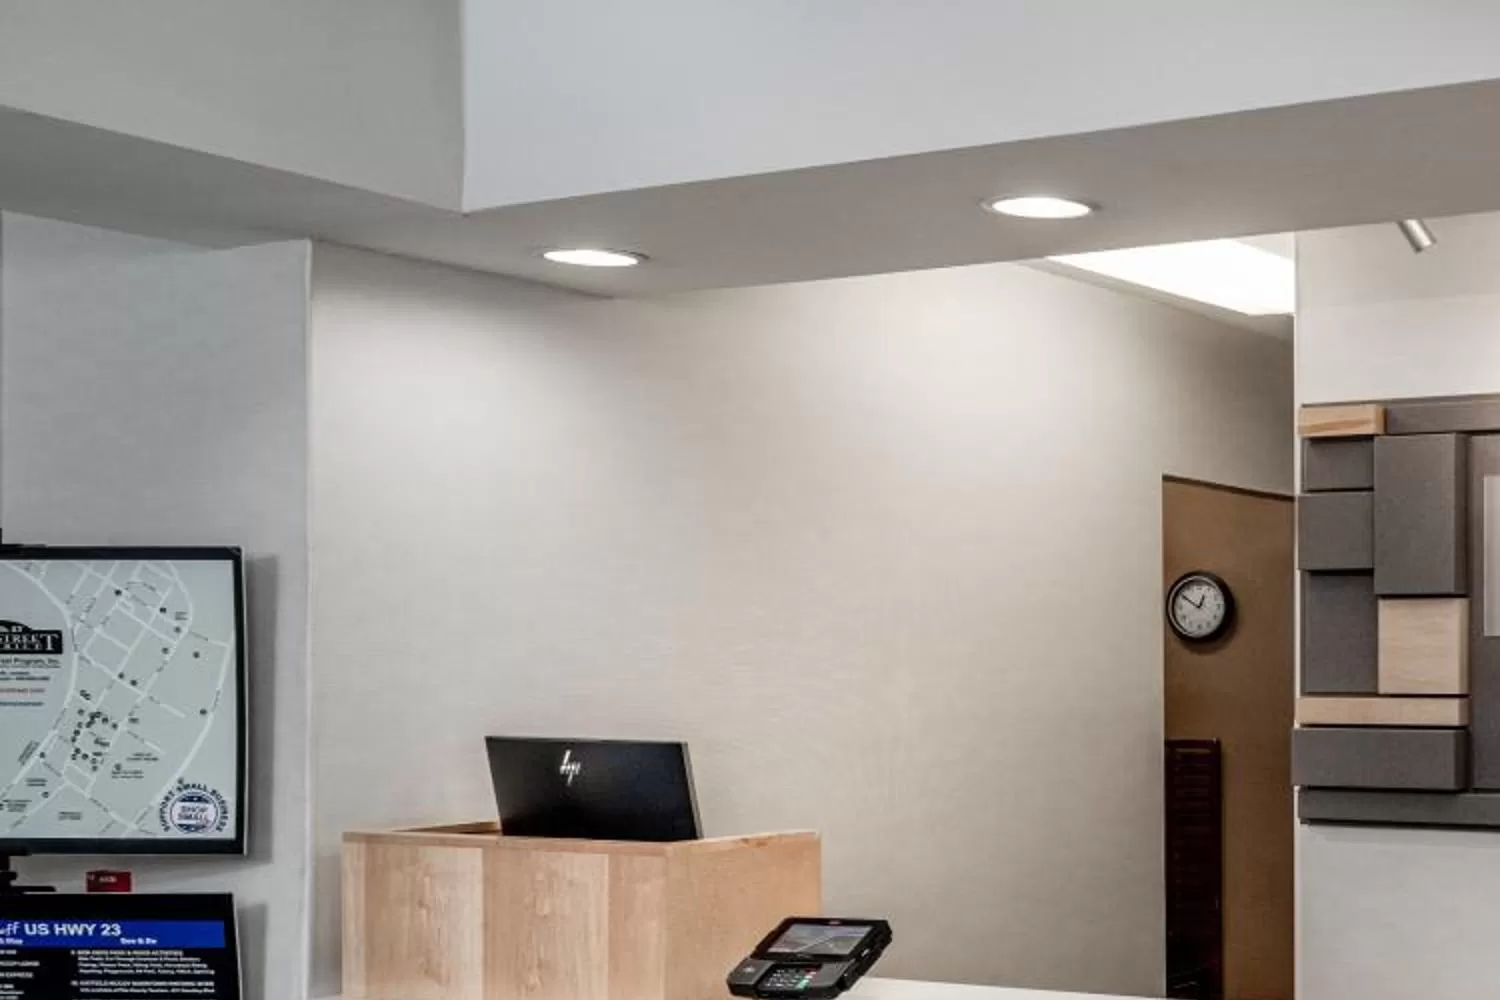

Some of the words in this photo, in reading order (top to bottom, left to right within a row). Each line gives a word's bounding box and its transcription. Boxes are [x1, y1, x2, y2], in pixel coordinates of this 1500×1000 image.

[559, 749, 581, 787] hp
[24, 923, 49, 936] US
[54, 923, 97, 937] HWY
[100, 923, 121, 937] 23
